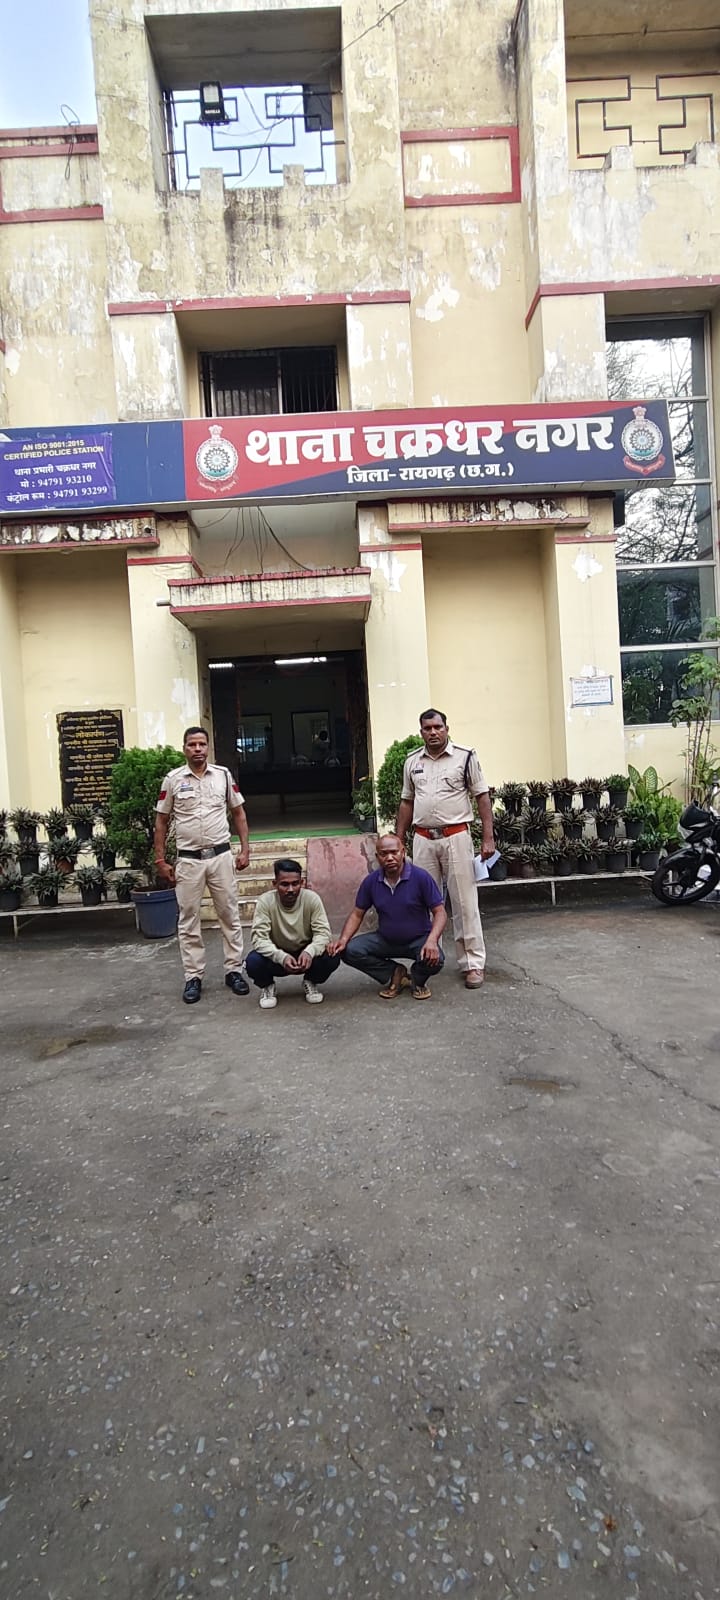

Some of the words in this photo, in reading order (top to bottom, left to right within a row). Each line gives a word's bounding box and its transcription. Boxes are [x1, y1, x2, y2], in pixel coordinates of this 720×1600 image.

[22, 443, 34, 451] AN
[34, 442, 48, 451] ISO
[49, 440, 84, 449] 9001:2015
[245, 426, 355, 466] थाना
[362, 419, 505, 461] चक्रधर
[512, 416, 614, 453] नगर
[3, 451, 43, 460] CERTIFIED
[44, 448, 71, 457] POLICE
[73, 446, 104, 455] STATION
[14, 467, 31, 476] थाना
[32, 463, 54, 476] प्रभारी
[56, 464, 80, 473] चक्रधर
[82, 461, 97, 470] नगर
[346, 466, 396, 484] जिला-
[398, 463, 456, 483] रायगढ़
[459, 462, 515, 478] (छ.ग.)
[20, 478, 30, 488] मो
[37, 476, 63, 487] 94791
[66, 474, 92, 485] 93210
[6, 491, 30, 504] कंट्रोल
[31, 491, 46, 501] रूम
[53, 488, 78, 499] 94791
[81, 485, 108, 497] 93299
